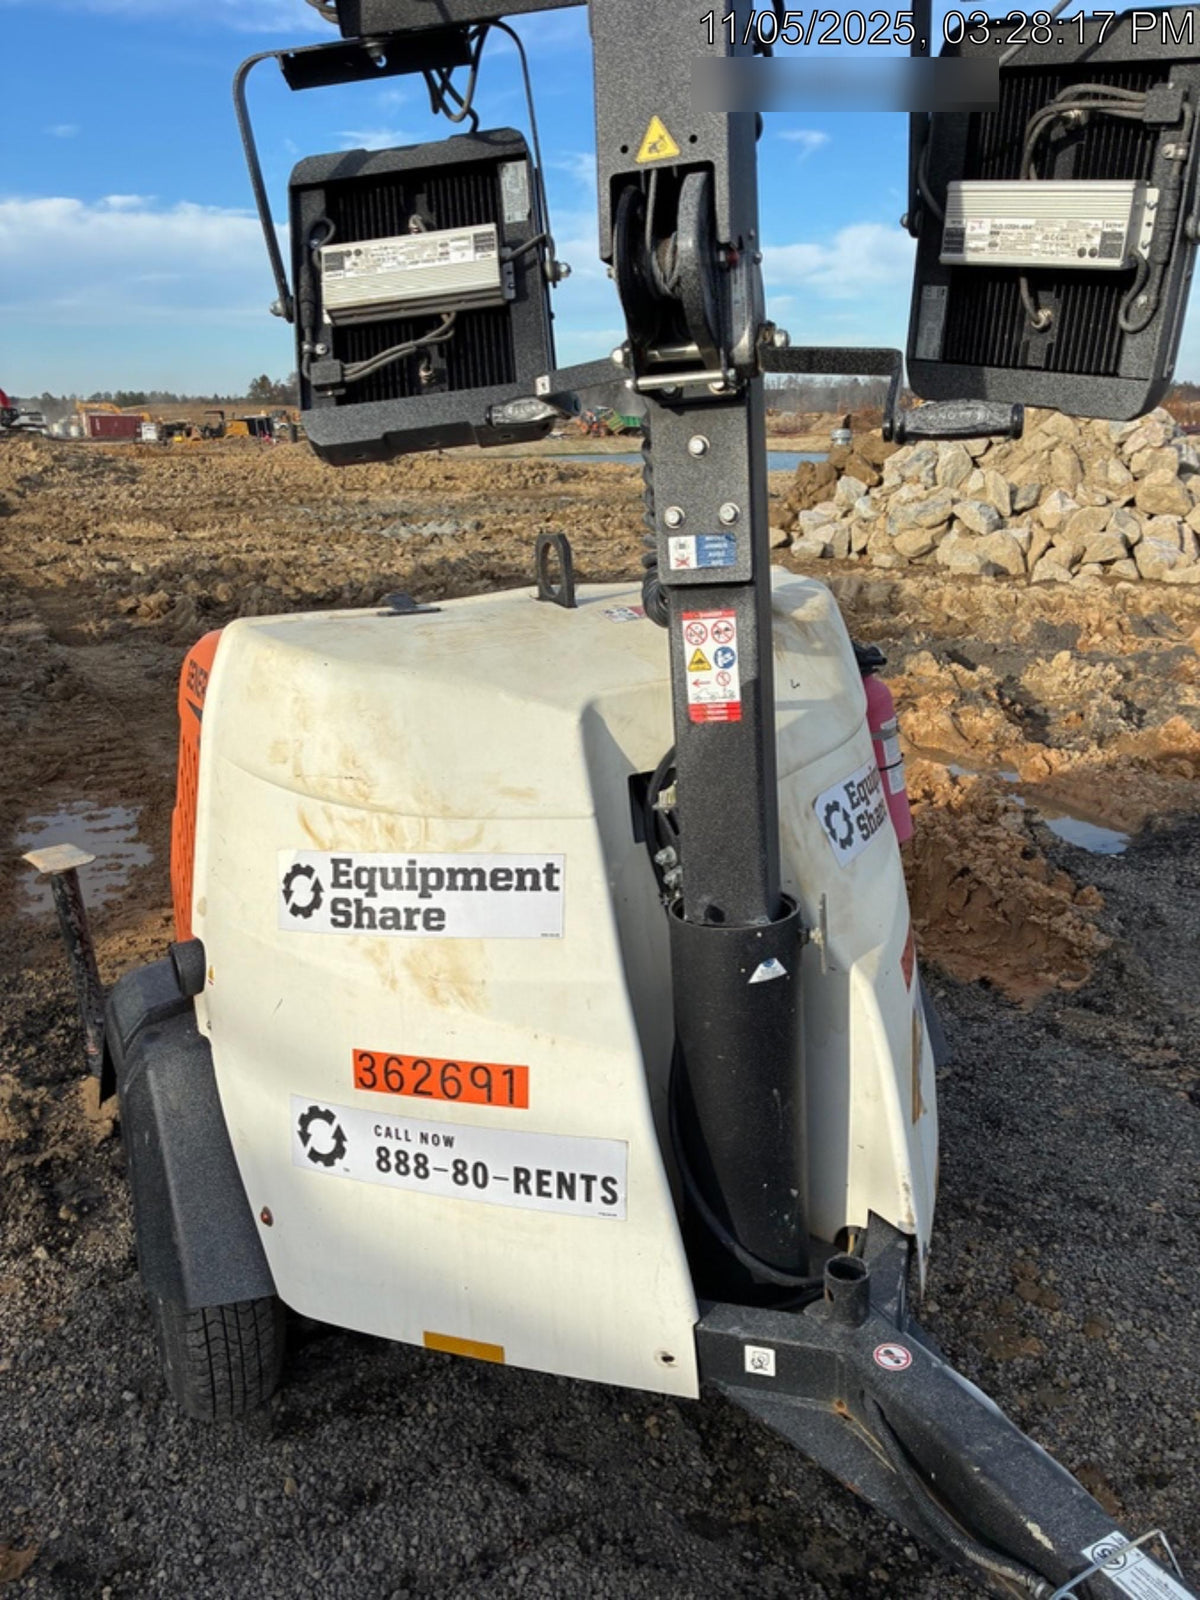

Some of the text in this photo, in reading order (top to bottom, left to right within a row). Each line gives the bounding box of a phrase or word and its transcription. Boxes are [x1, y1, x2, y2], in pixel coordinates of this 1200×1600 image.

[330, 858, 560, 898] Equipment
[330, 897, 446, 931] Share
[358, 1052, 516, 1105] 362691
[373, 1124, 456, 1149] CALL NOW
[375, 1146, 619, 1206] 888-80-RENTS
